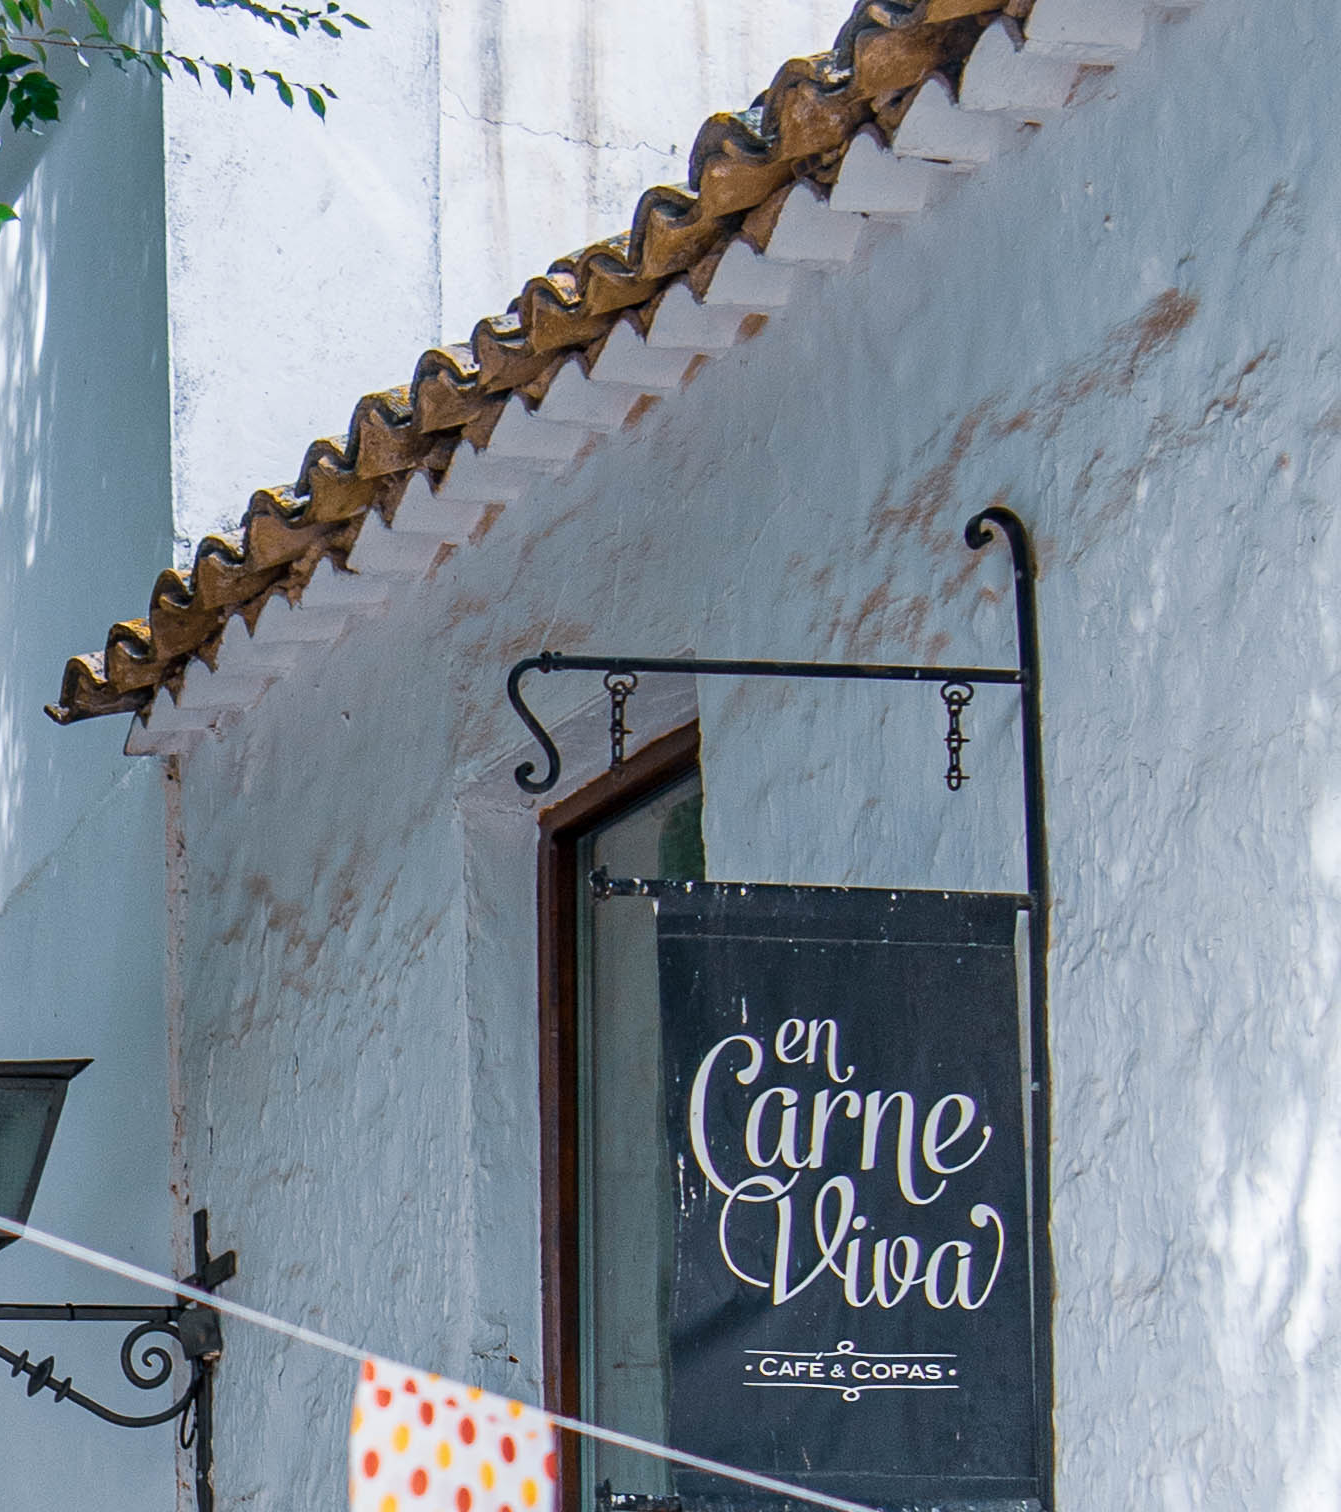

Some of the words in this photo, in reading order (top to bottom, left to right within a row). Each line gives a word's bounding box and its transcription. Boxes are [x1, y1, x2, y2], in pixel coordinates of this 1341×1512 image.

[774, 1017, 854, 1084] en
[688, 1035, 992, 1205] Carne
[719, 1175, 1004, 1311] Viva
[758, 1351, 825, 1379] CAFÉ
[830, 1363, 846, 1379] &
[851, 1359, 942, 1381] COPAS
